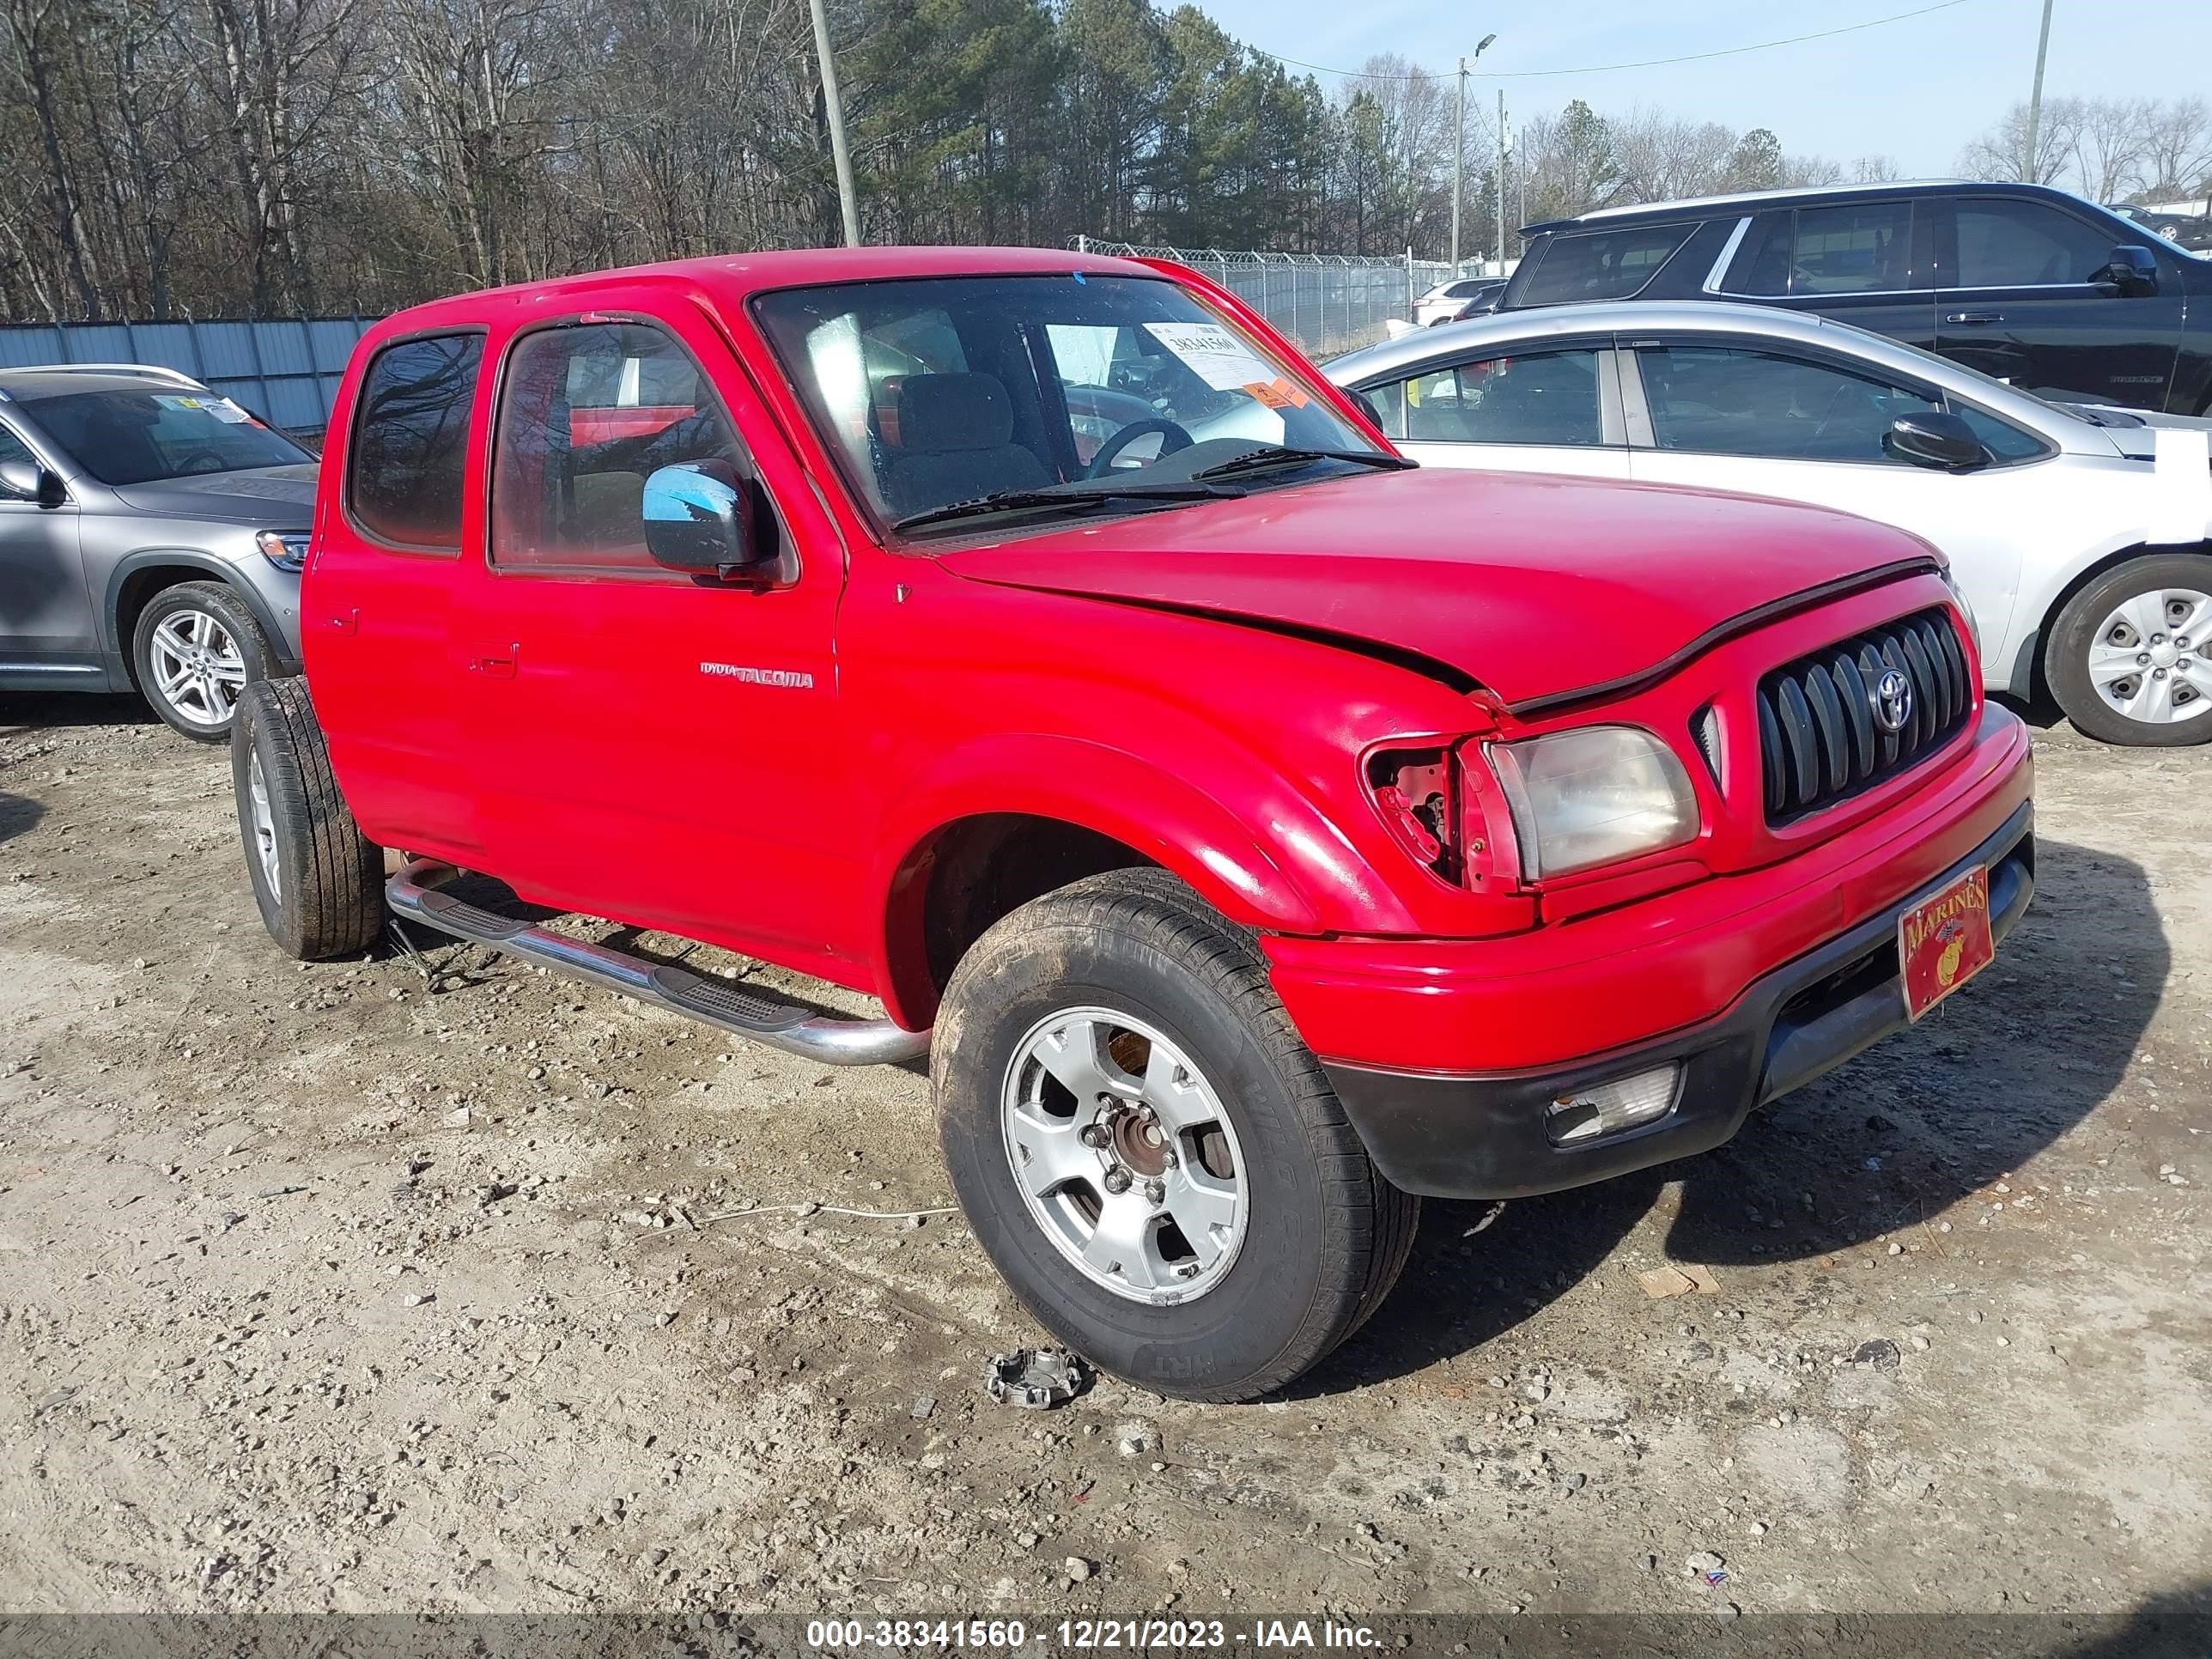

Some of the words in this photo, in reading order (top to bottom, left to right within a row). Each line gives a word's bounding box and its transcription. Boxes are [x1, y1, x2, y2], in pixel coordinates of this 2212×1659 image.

[1169, 337, 1237, 351] 38341560
[700, 662, 737, 676] TOYOTA
[737, 667, 813, 688] TACOMA
[1907, 884, 1986, 947] MARINES
